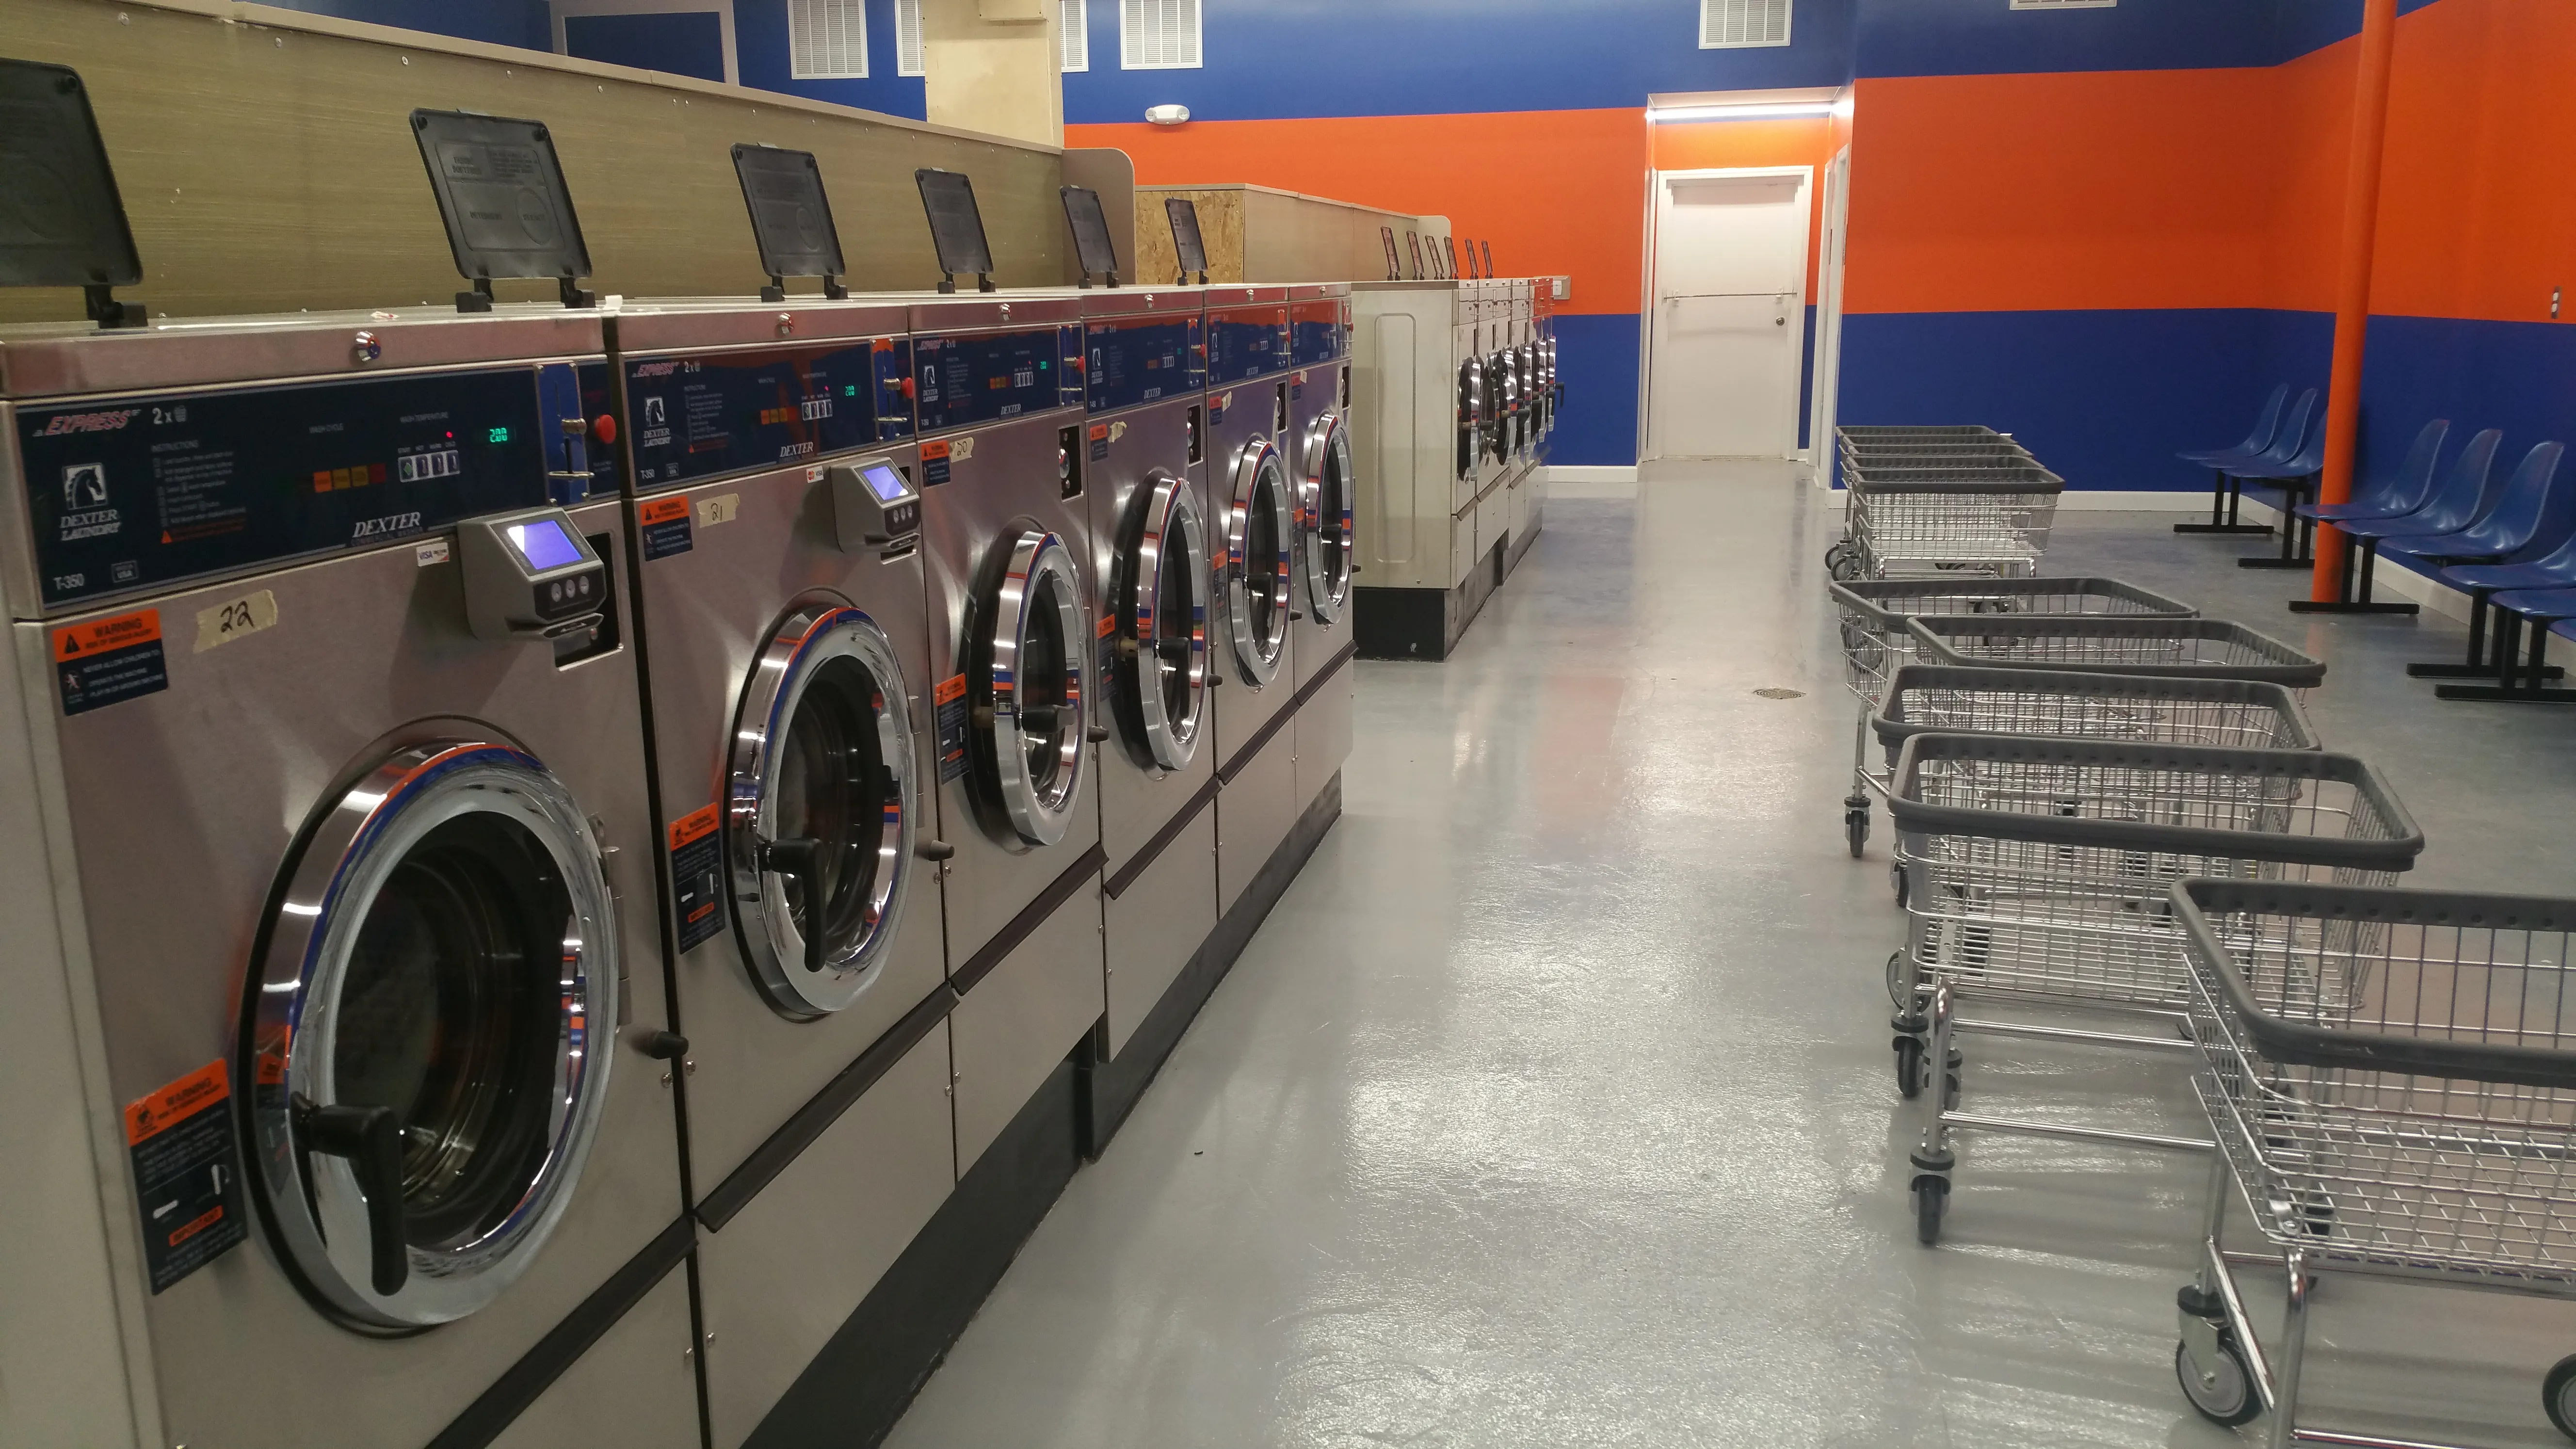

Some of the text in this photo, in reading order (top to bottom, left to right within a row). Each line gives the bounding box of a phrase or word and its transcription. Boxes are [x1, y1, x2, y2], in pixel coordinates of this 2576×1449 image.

[1143, 386, 1161, 400] DEXTER
[152, 407, 163, 425] 2
[1000, 403, 1022, 416] DEXTER
[46, 410, 131, 435] EXPRESS
[779, 441, 814, 457] DEXTER
[60, 509, 119, 529] DEXTER
[710, 502, 723, 522] 21
[352, 512, 422, 538] DEXTER
[220, 600, 255, 633] 22
[93, 617, 142, 638] WARNING
